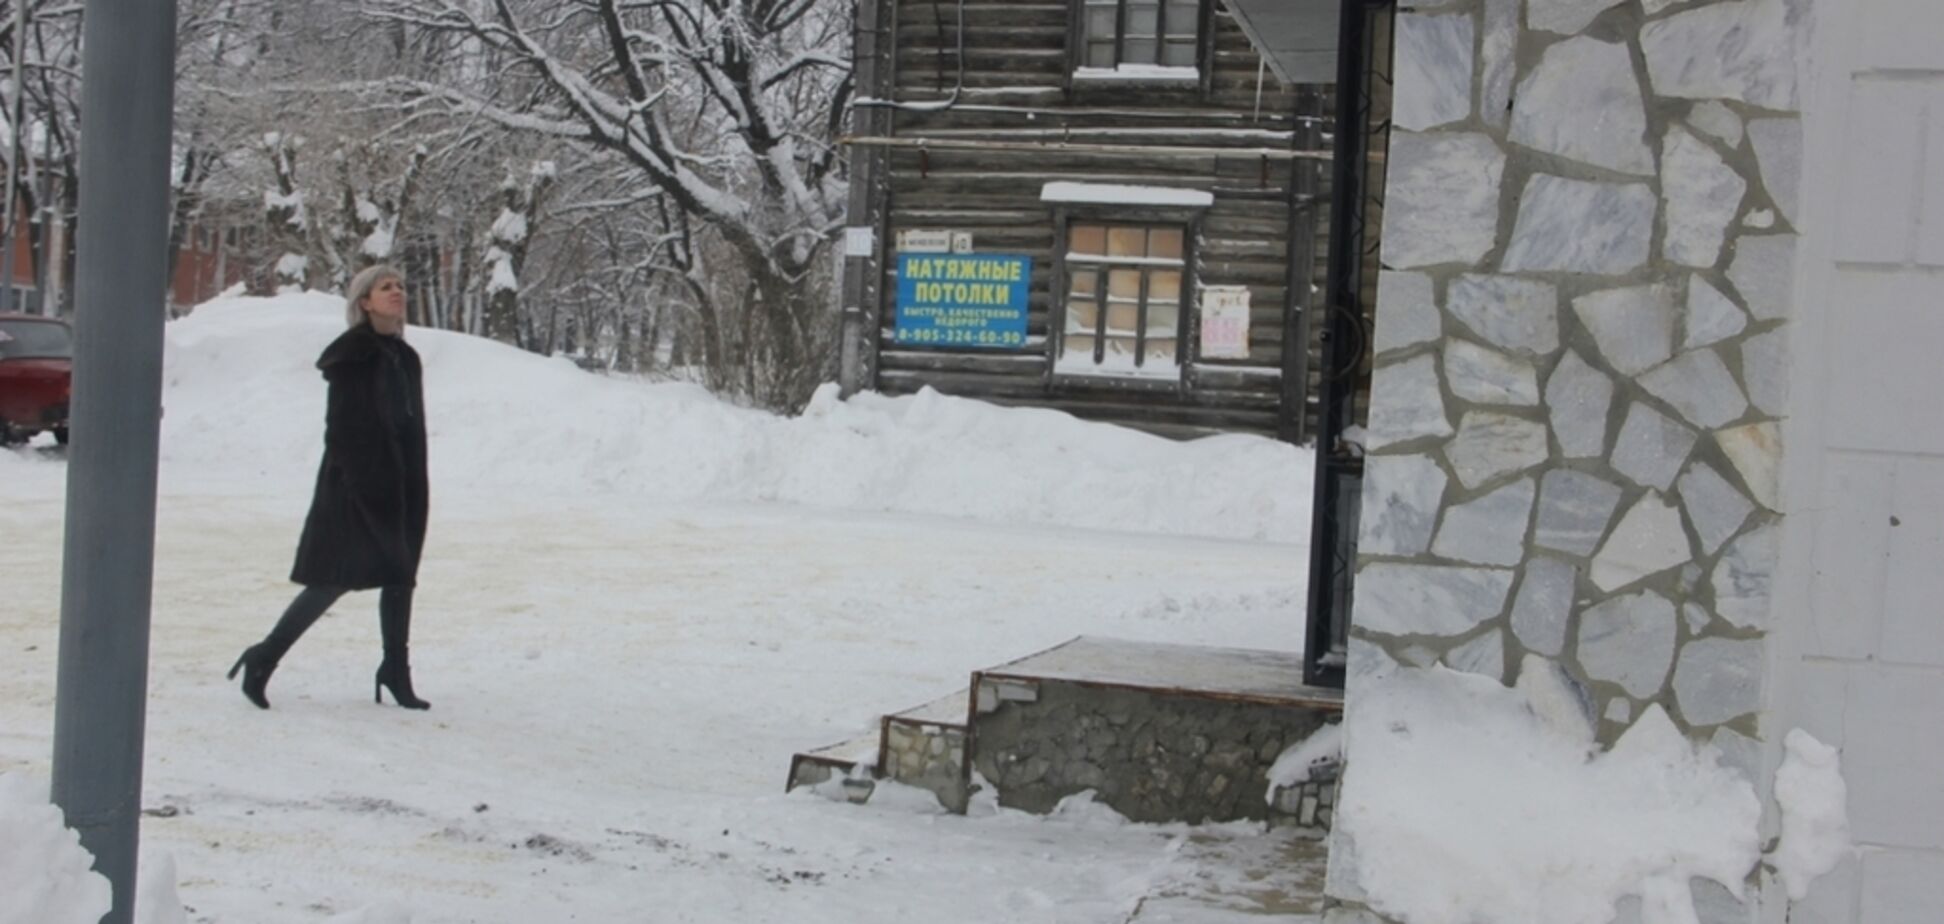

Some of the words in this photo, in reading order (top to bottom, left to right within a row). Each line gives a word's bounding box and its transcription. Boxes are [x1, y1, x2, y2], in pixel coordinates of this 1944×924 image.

[906, 258, 1022, 281] НАТЯЖНЫЕ
[915, 282, 1009, 305] ПОТОЛКИ
[934, 316, 988, 327] НЕДОРОГО
[948, 308, 1020, 319] КАЧЕСТВЕННО
[899, 327, 1021, 344] 8-905-324-60-90
